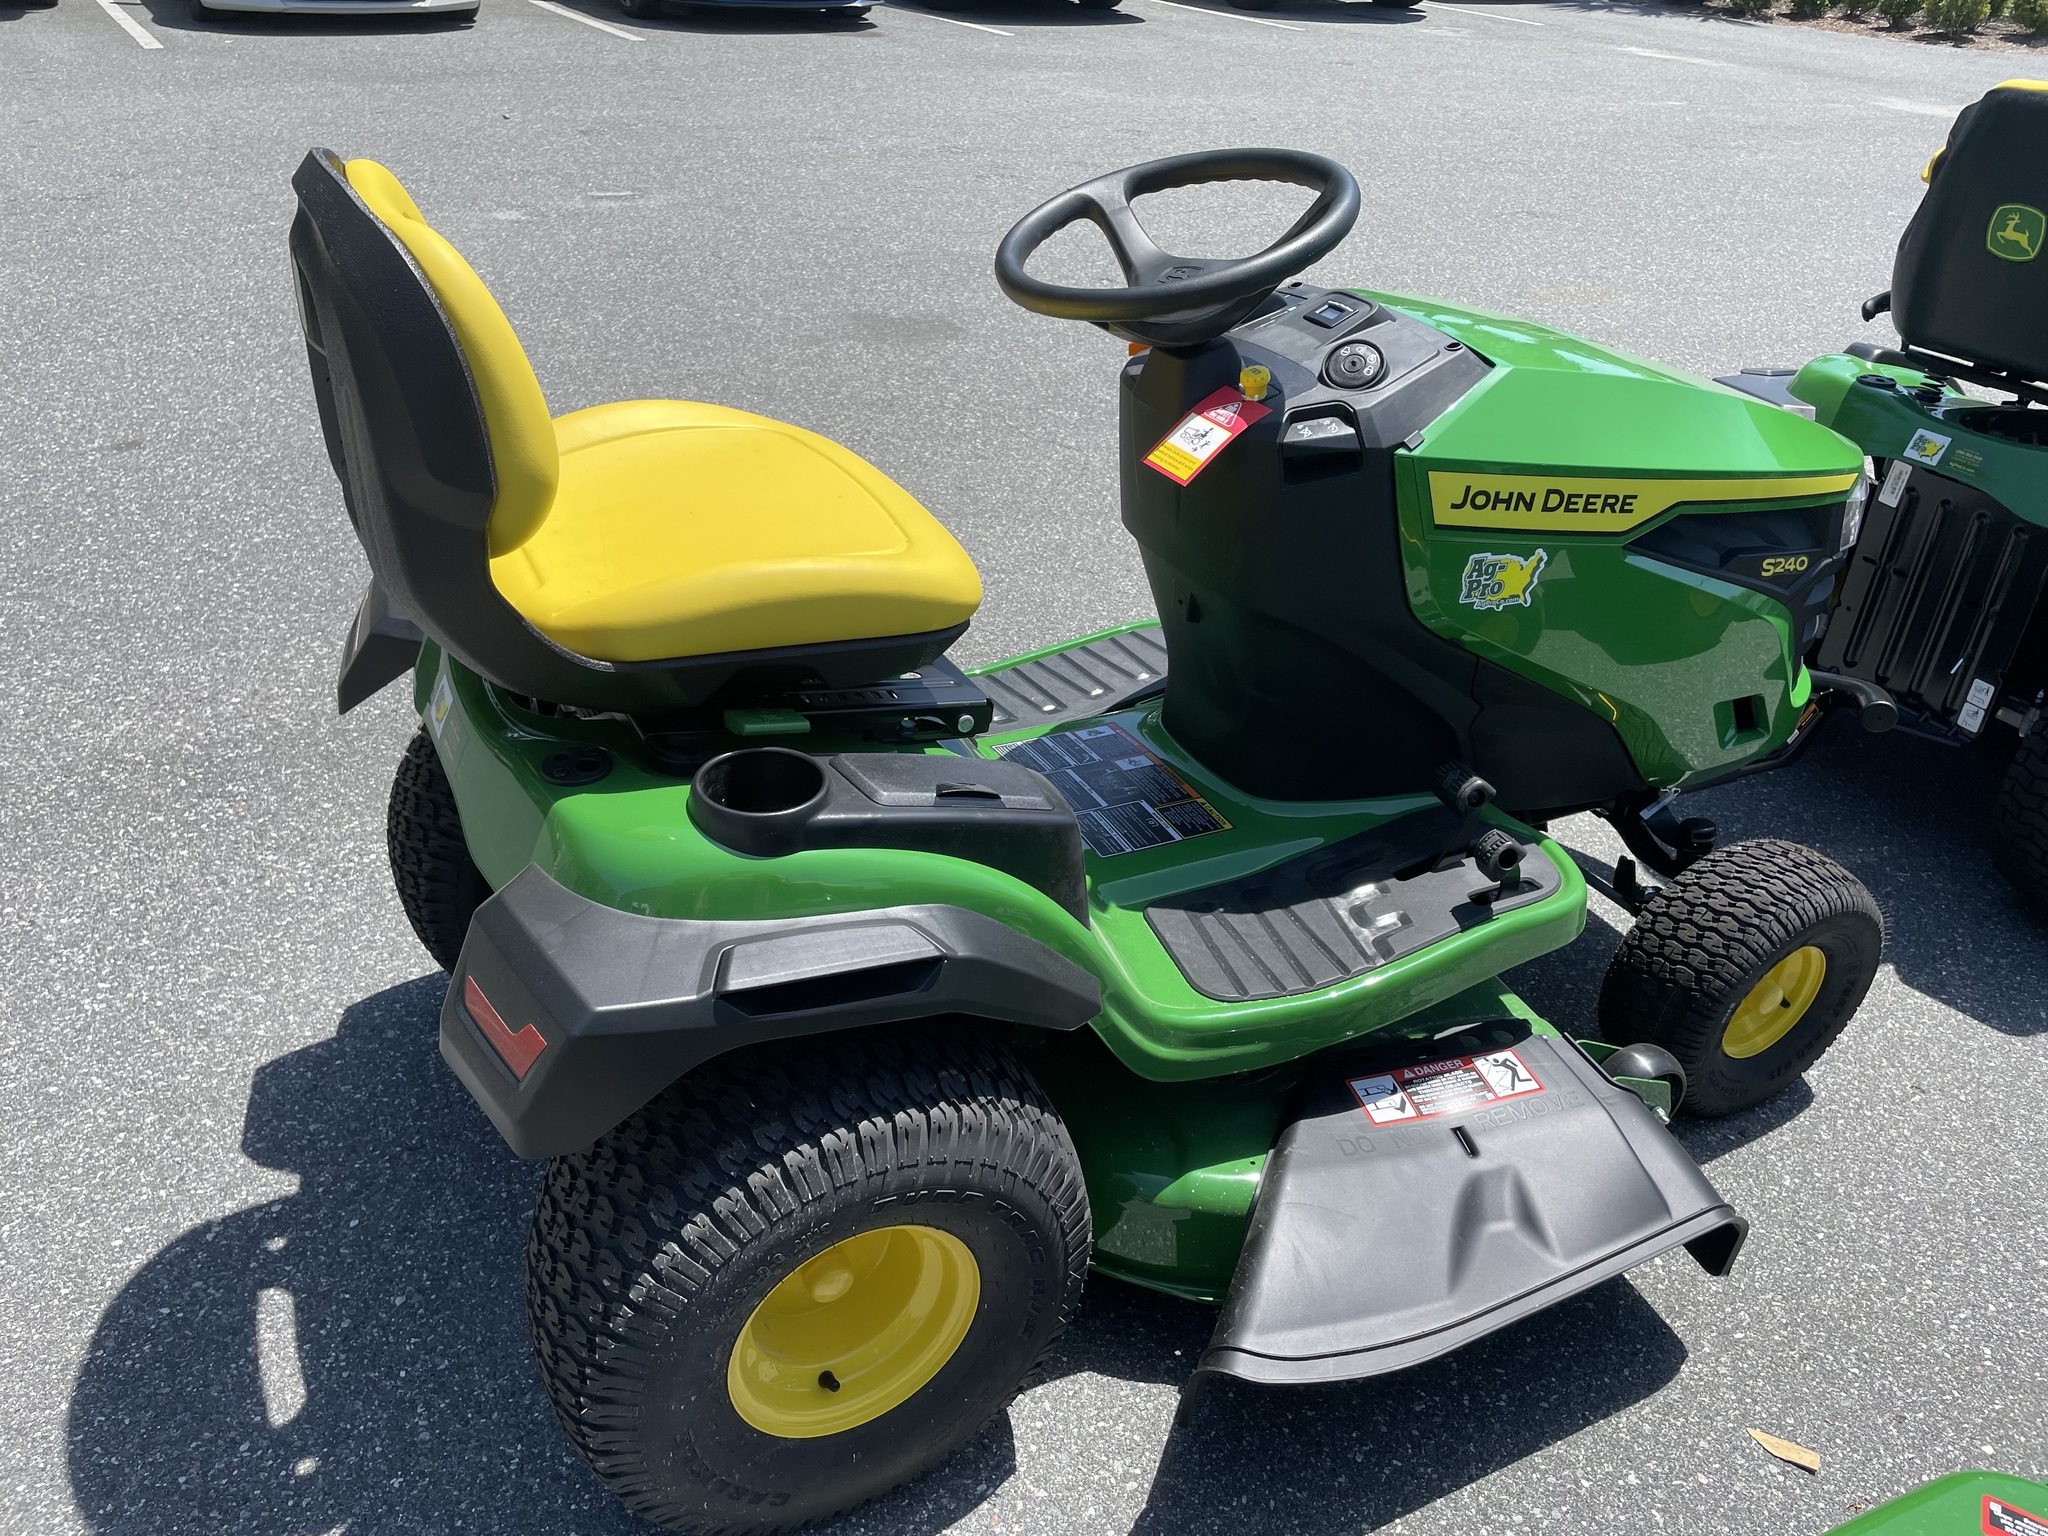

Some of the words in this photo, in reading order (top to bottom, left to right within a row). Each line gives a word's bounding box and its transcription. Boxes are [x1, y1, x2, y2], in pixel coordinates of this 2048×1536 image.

[1451, 485, 1536, 512] JOHN
[1541, 489, 1638, 514] DEERE
[1467, 557, 1507, 582] Ag-
[1761, 556, 1808, 577] S240
[1463, 579, 1504, 600] Pro
[1203, 804, 1228, 827] CAUTION
[1412, 1073, 1444, 1084] ROTATING
[1414, 1060, 1465, 1076] DANGER
[1334, 1137, 1377, 1157] DO
[1391, 1124, 1443, 1149] NOT
[1473, 1089, 1586, 1133] REMOVE
